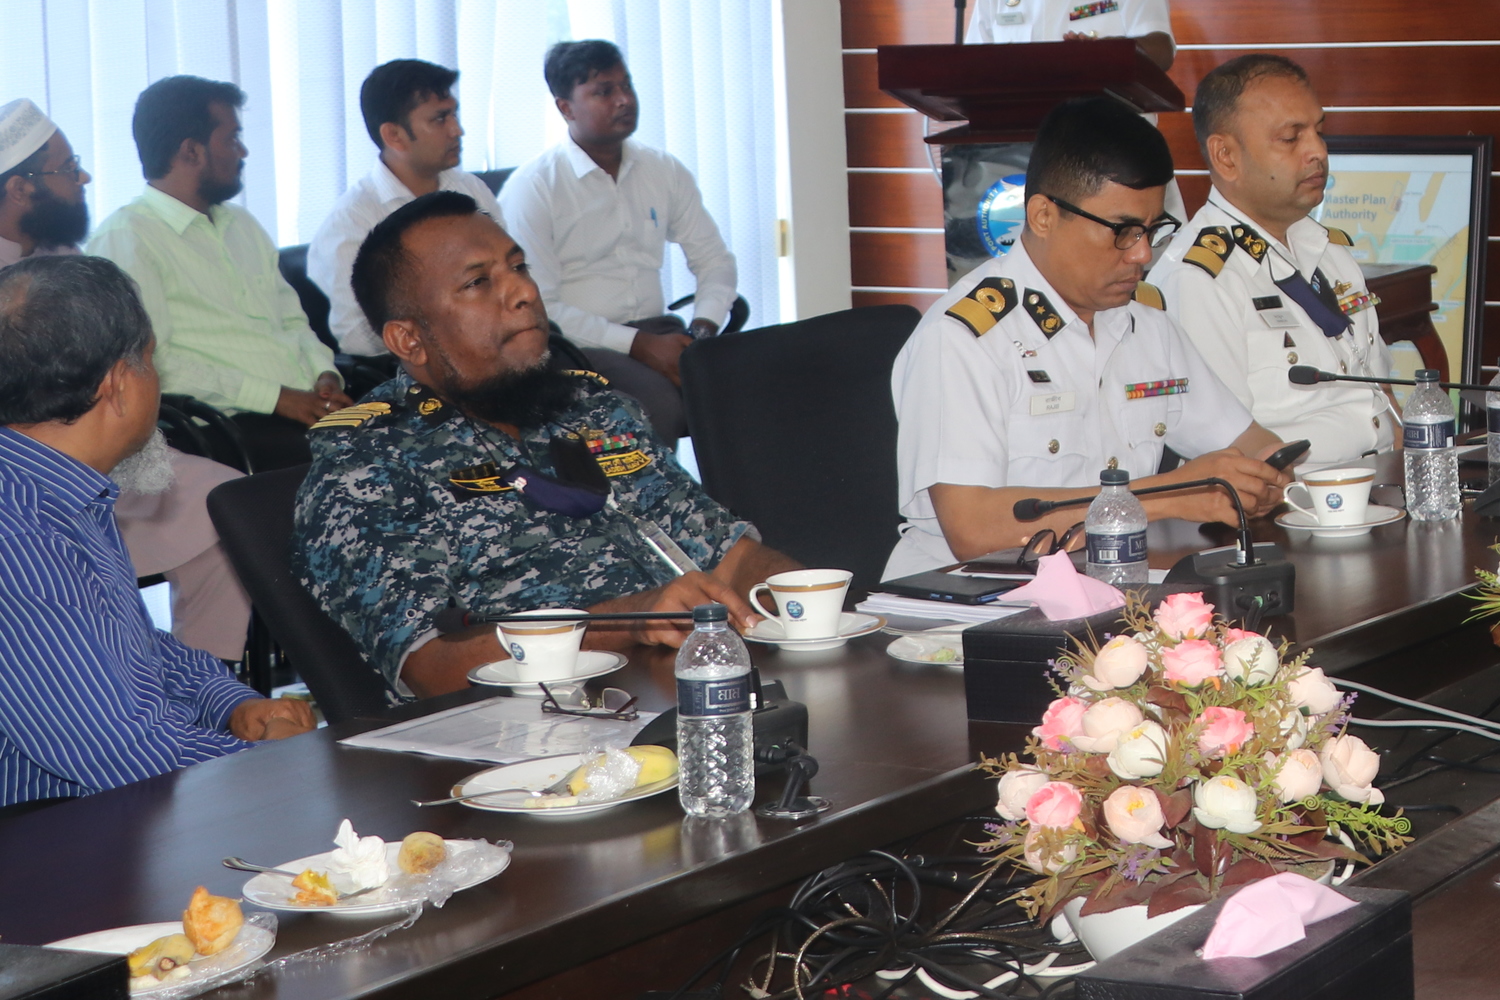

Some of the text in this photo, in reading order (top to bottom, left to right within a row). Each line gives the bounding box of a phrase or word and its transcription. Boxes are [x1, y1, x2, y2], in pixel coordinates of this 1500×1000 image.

[1362, 193, 1387, 205] Plan
[981, 187, 999, 230] AUTHORITY
[1324, 208, 1378, 222] Authority
